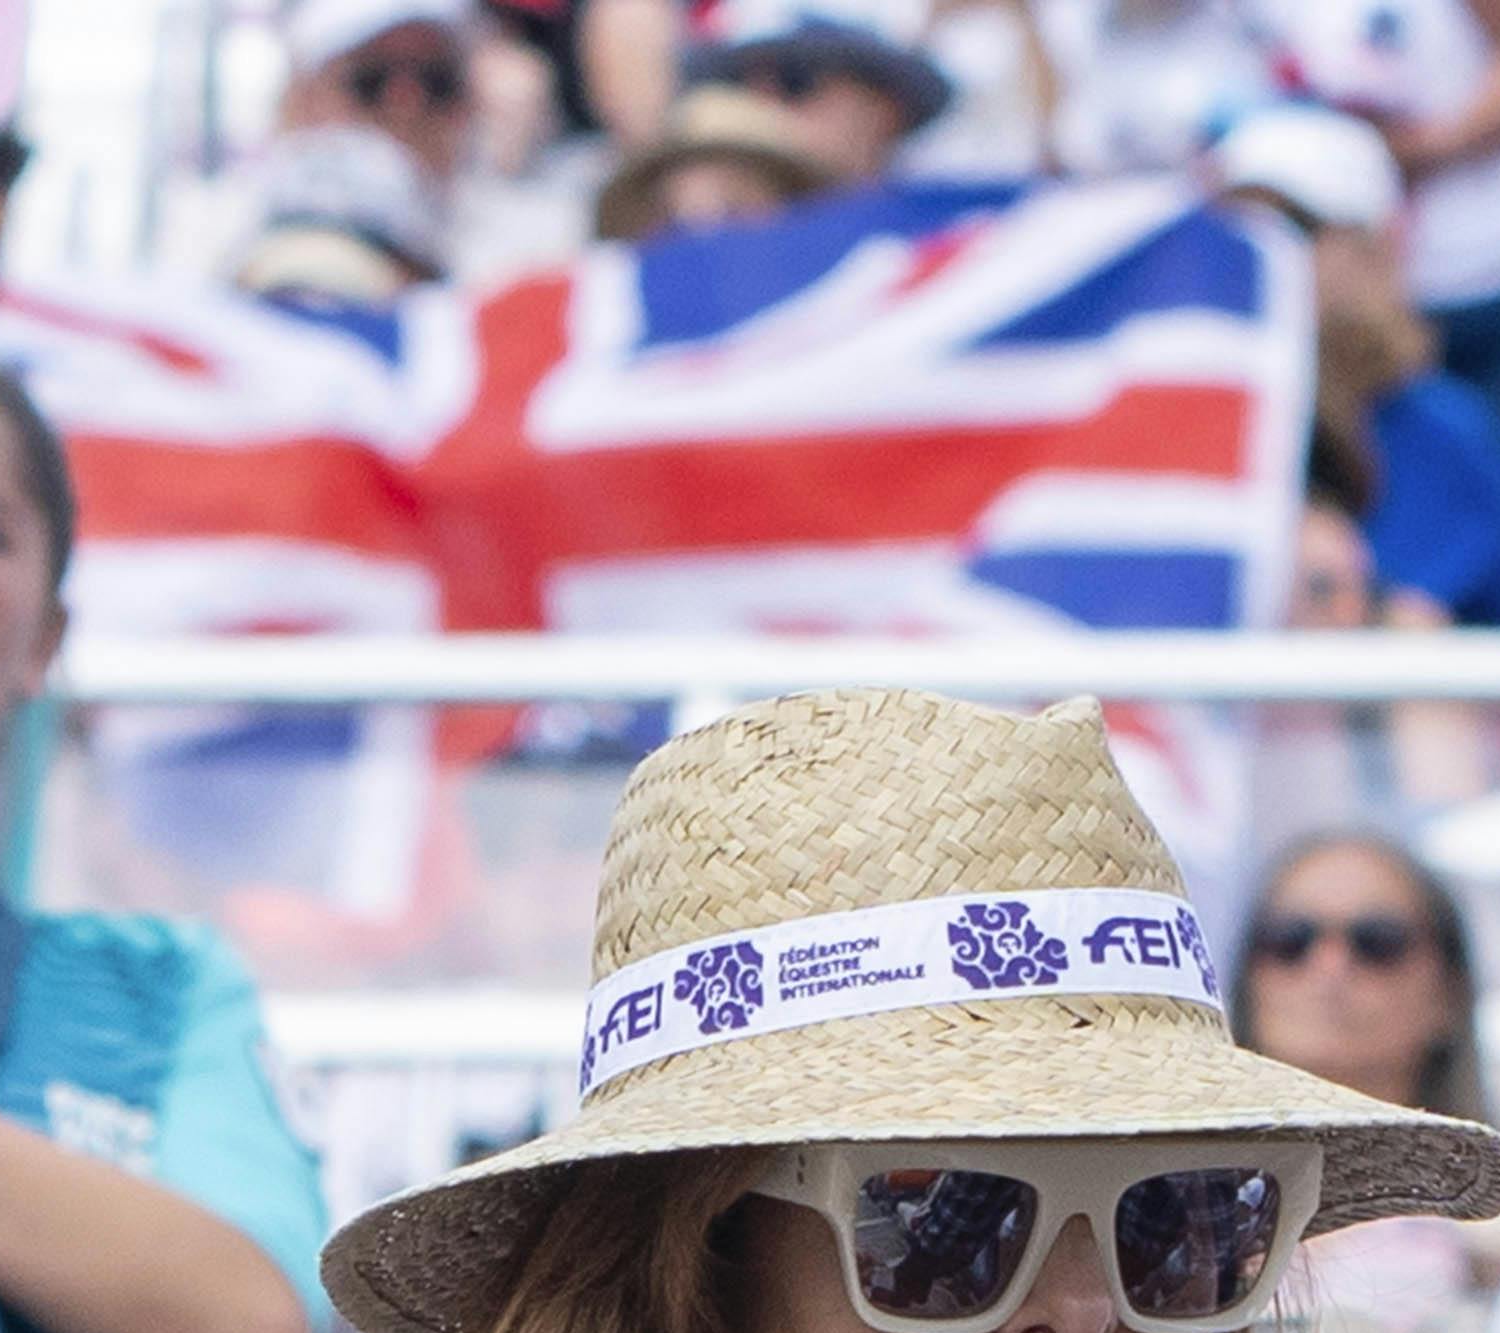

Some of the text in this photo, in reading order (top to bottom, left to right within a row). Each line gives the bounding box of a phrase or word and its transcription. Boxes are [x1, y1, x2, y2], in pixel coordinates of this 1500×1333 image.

[777, 936, 881, 968] FÉDÉRATION
[778, 955, 862, 986] ÉQUESTRE
[778, 963, 926, 1002] INTERNATIONALE
